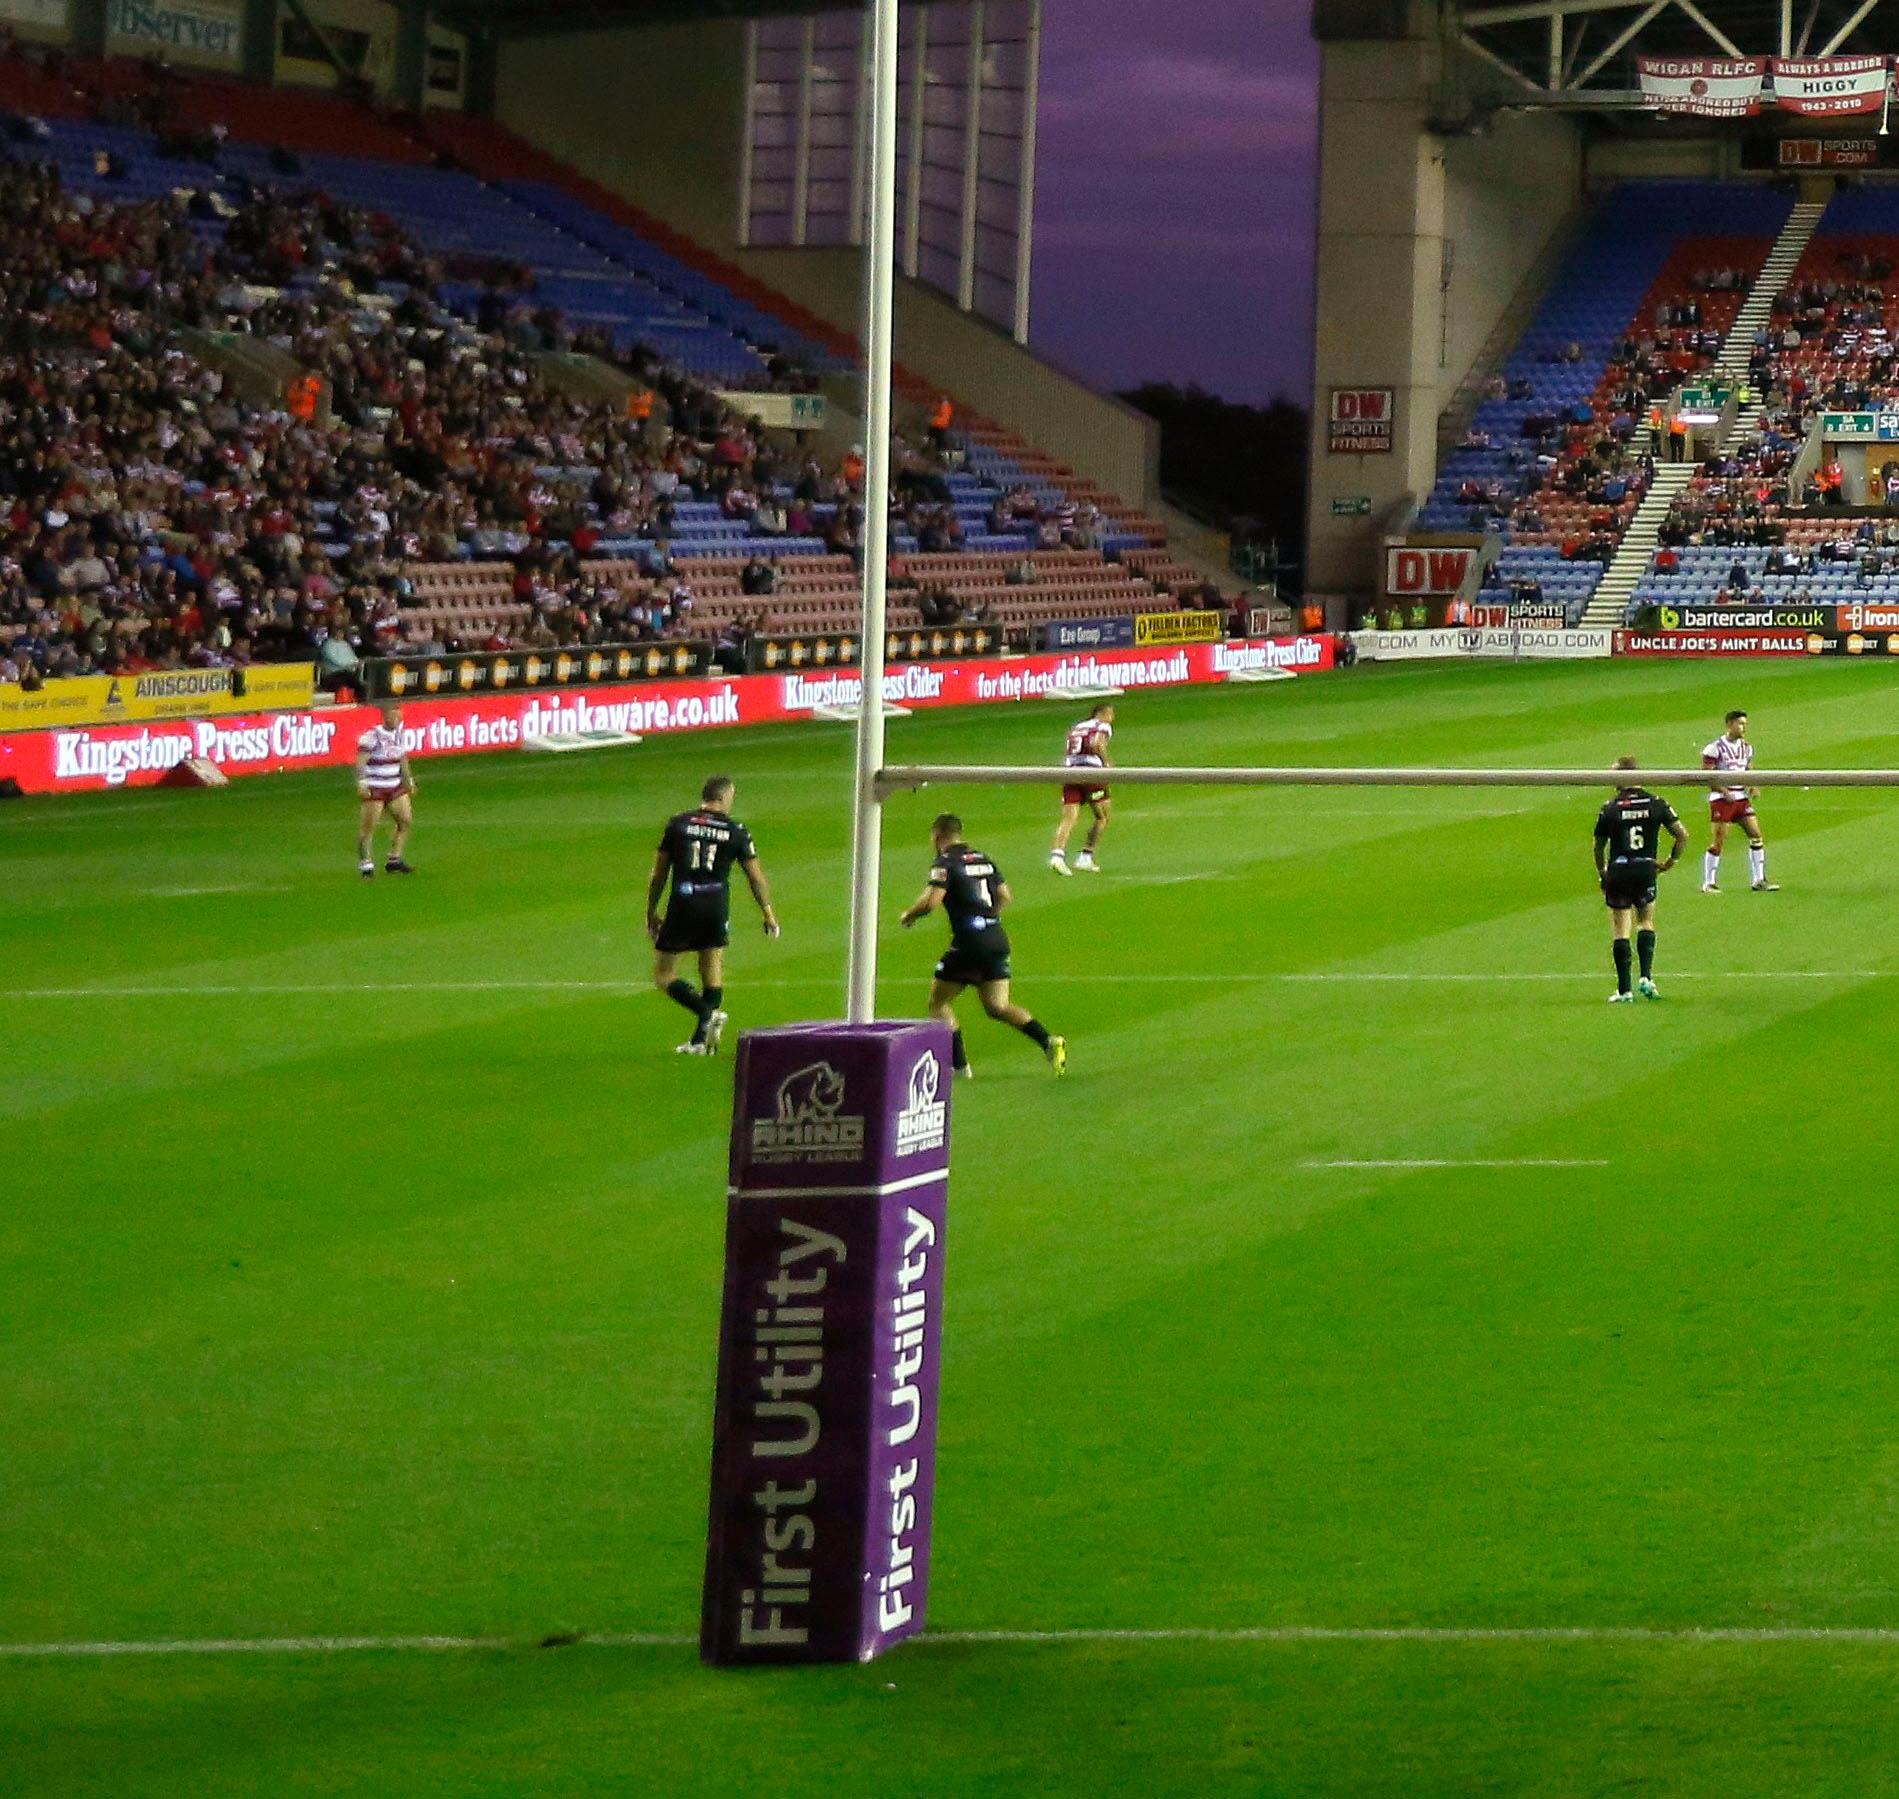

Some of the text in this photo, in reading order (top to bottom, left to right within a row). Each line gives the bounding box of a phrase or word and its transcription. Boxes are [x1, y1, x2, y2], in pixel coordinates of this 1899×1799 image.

[1645, 63, 1757, 75] WIGAN RLFC
[1778, 62, 1819, 76] ALWAYS
[1803, 79, 1857, 93] HIGGY
[1338, 392, 1385, 420] DW
[1839, 423, 1858, 432] EXIT
[1397, 552, 1469, 591] DW
[1510, 606, 1564, 616] SPORTS
[1510, 618, 1564, 628] FITNESS
[1685, 609, 1824, 628] bartercard.co.uk
[1430, 633, 1454, 649] MY
[1631, 638, 1804, 650] UNCLE JOE'S MINT BALLS
[1213, 638, 1322, 672] Kingstone Press Cider
[977, 650, 1190, 698] for the facts drinkaware.co.uk
[784, 665, 944, 710] Kingstone Cider
[430, 686, 740, 749] the facts drinkaware.co.uk
[55, 715, 336, 785] Kingstone Press Cider
[1630, 826, 1644, 850] 6
[753, 1123, 863, 1145] RHINO
[899, 1107, 945, 1138] RHINO
[739, 1218, 848, 1647] First Utility
[879, 1206, 937, 1635] First Utility
